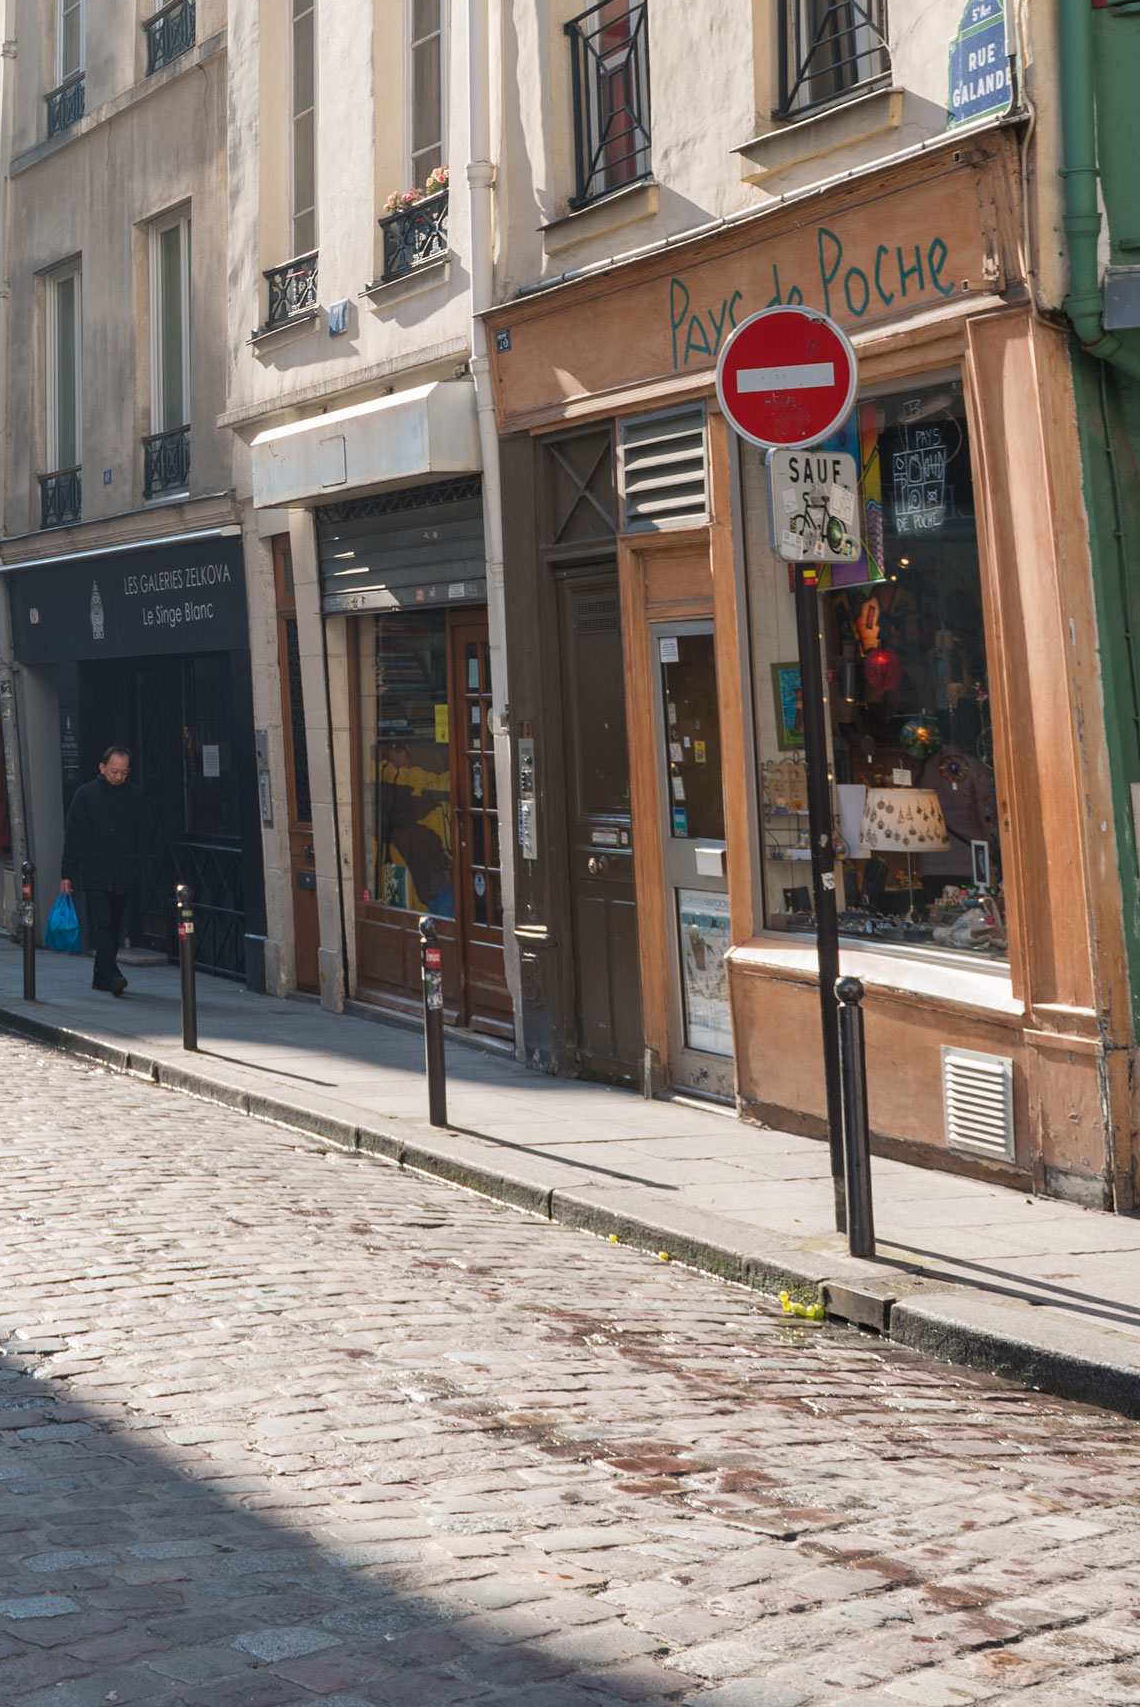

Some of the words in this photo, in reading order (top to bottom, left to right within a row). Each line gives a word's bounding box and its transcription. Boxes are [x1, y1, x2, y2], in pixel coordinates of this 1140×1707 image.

[968, 43, 996, 72] RUE
[952, 67, 1011, 107] GALANDE
[915, 428, 941, 447] PAYS
[788, 457, 841, 483] SAUF
[896, 517, 909, 532] DE
[913, 511, 941, 530] POCHE
[124, 576, 138, 595] LES
[140, 570, 183, 593] GALERIES
[185, 563, 231, 587] ZELKOVA
[142, 607, 153, 625] Le
[155, 605, 182, 628] Singe
[184, 602, 214, 622] Blanc
